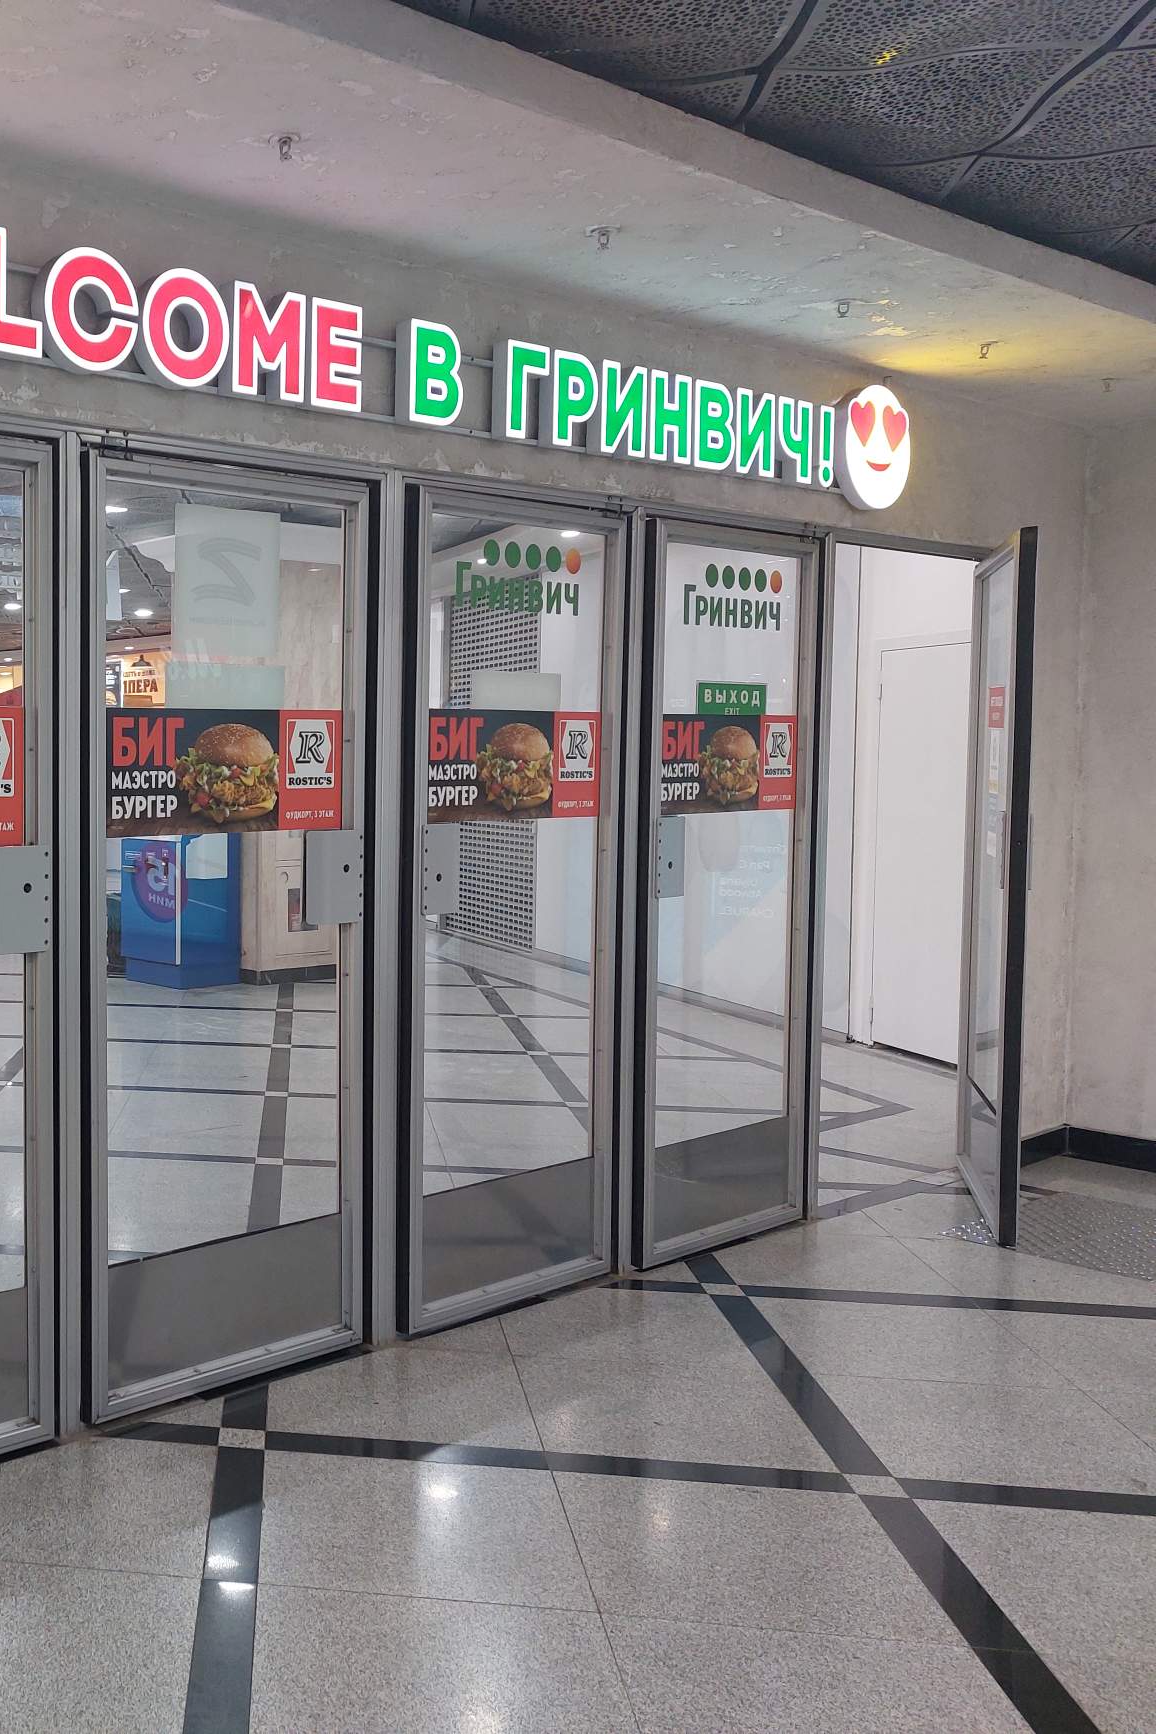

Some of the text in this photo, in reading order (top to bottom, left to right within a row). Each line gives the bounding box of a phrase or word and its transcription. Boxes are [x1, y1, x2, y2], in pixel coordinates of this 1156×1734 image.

[410, 318, 463, 426] В
[506, 339, 834, 488] ГРИНВИЧ!
[704, 688, 761, 708] ВЫХОД
[724, 707, 740, 715] EXIT
[112, 716, 184, 767] БИГ
[430, 717, 484, 760] БИГ
[662, 721, 704, 760] БИГ
[111, 770, 176, 789] МАЭСТРО
[429, 764, 477, 780] МАЭСТРО
[560, 771, 593, 779] ROSTIC'S
[661, 763, 699, 778] МАЭСТРО
[288, 777, 332, 786] ROSTIC'S
[428, 785, 479, 807] БУРГЕР
[660, 782, 700, 801] БУРГЕР
[111, 795, 178, 820] БУРГЕР
